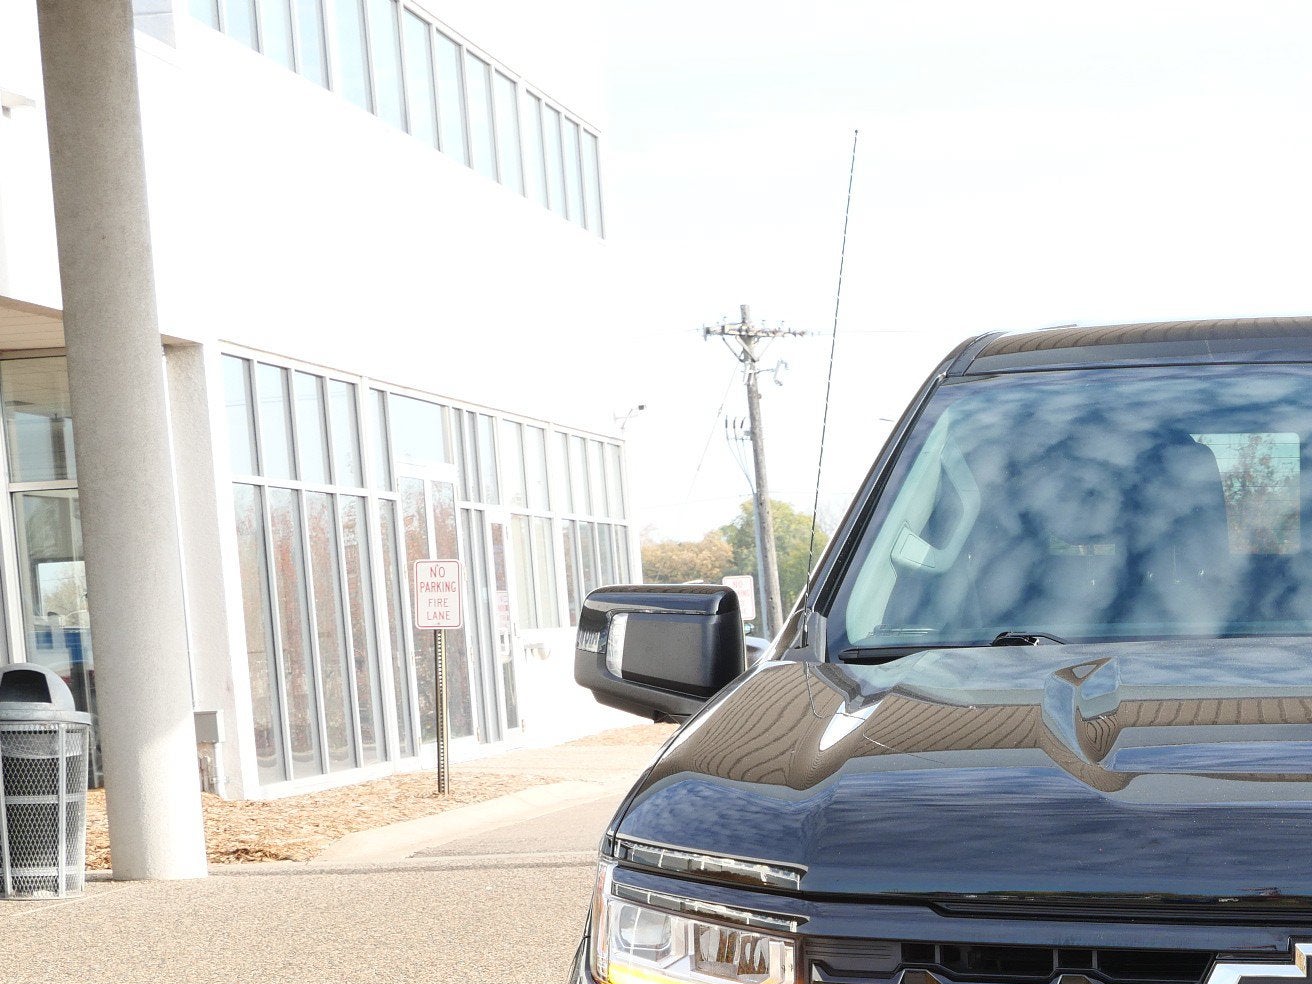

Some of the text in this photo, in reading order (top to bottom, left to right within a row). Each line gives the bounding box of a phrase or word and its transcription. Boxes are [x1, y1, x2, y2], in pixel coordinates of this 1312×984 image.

[430, 566, 445, 577] NO
[420, 581, 456, 592] PARKING
[428, 598, 448, 607] FIRE
[427, 611, 450, 620] LANE
